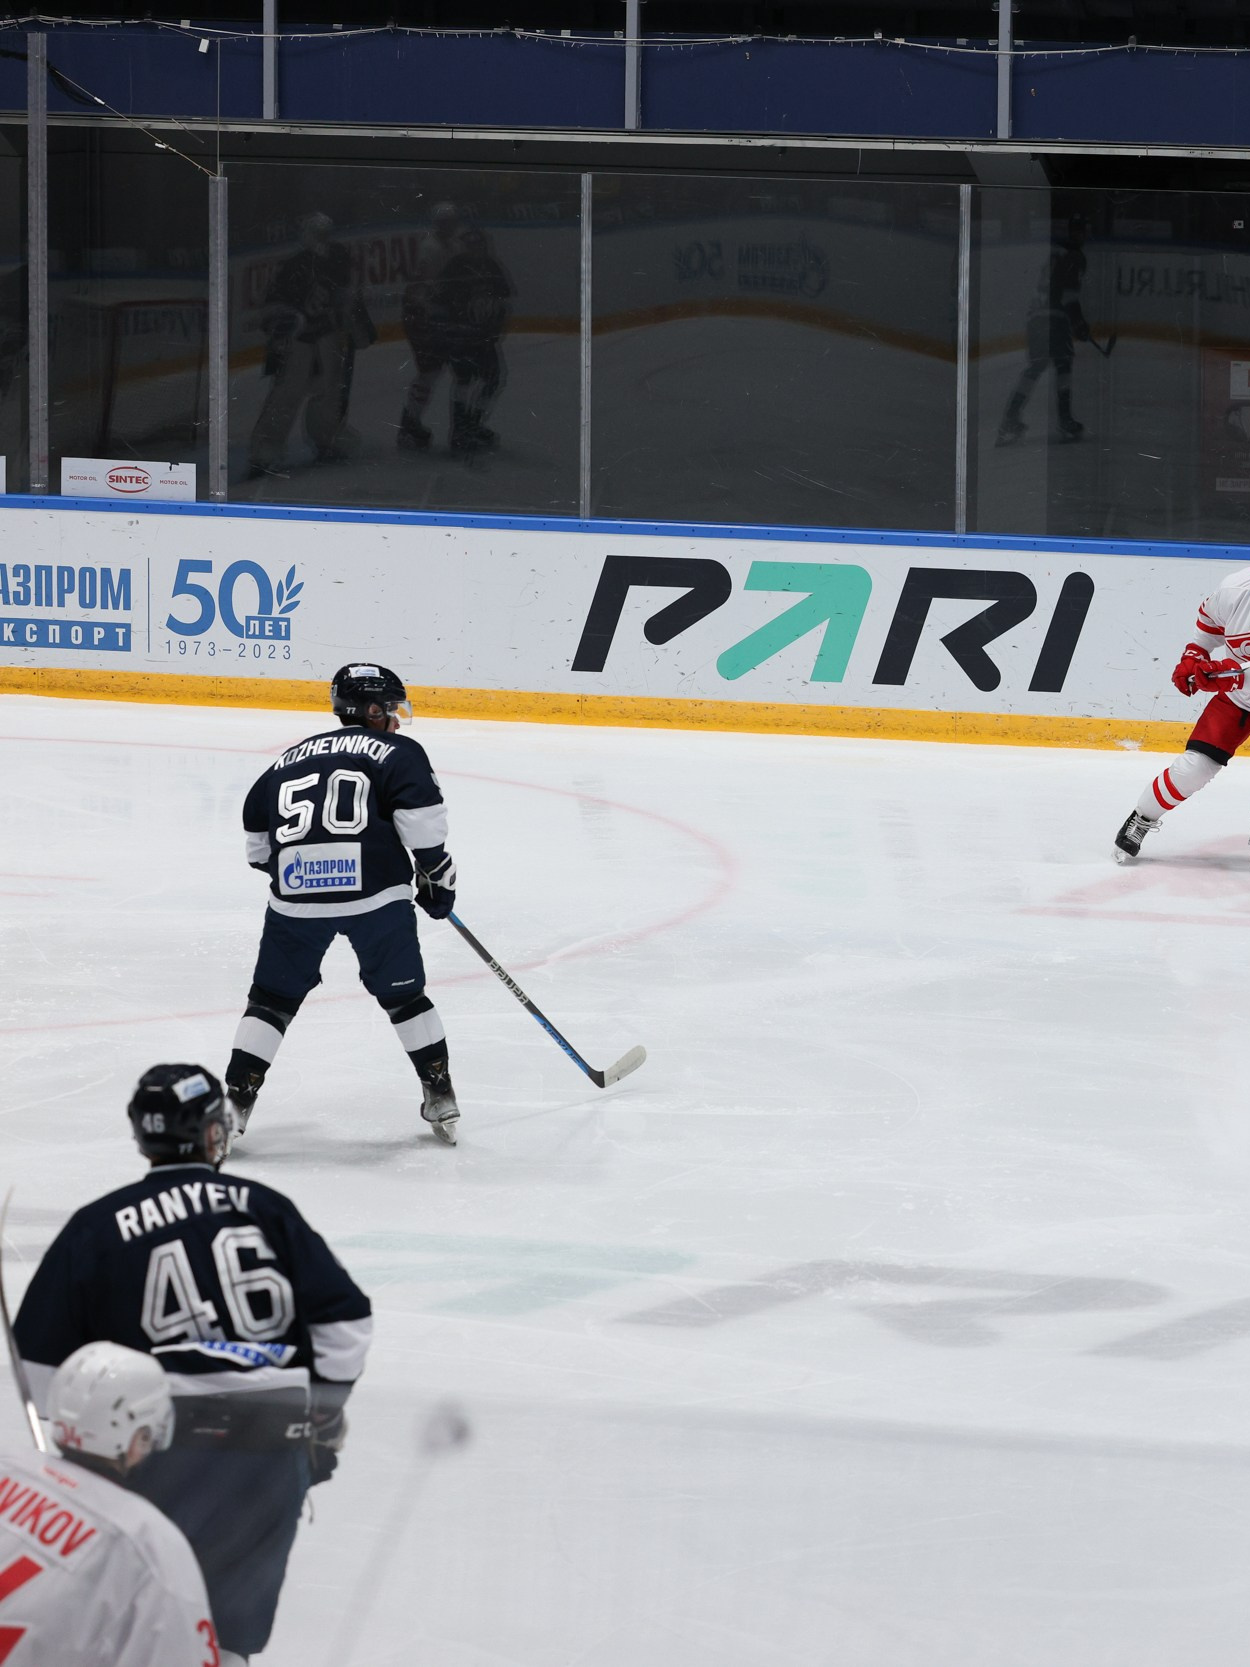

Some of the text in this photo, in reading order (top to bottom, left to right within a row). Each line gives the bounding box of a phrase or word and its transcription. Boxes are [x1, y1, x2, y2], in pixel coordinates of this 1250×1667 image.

[108, 474, 149, 485] SINTEC
[166, 559, 274, 638] 50
[248, 619, 288, 637] ЛЕТ
[274, 735, 396, 771] KOZHEVNIKOV
[275, 768, 371, 844] 50
[304, 858, 356, 876] ГАЗПРОМ
[304, 877, 355, 888] ЭКСПОРТ
[489, 958, 530, 1005] BAUER
[142, 1113, 166, 1134] 46
[115, 1181, 250, 1242] RANYEV
[140, 1224, 295, 1344] 46
[0, 1477, 97, 1557] VIKOV
